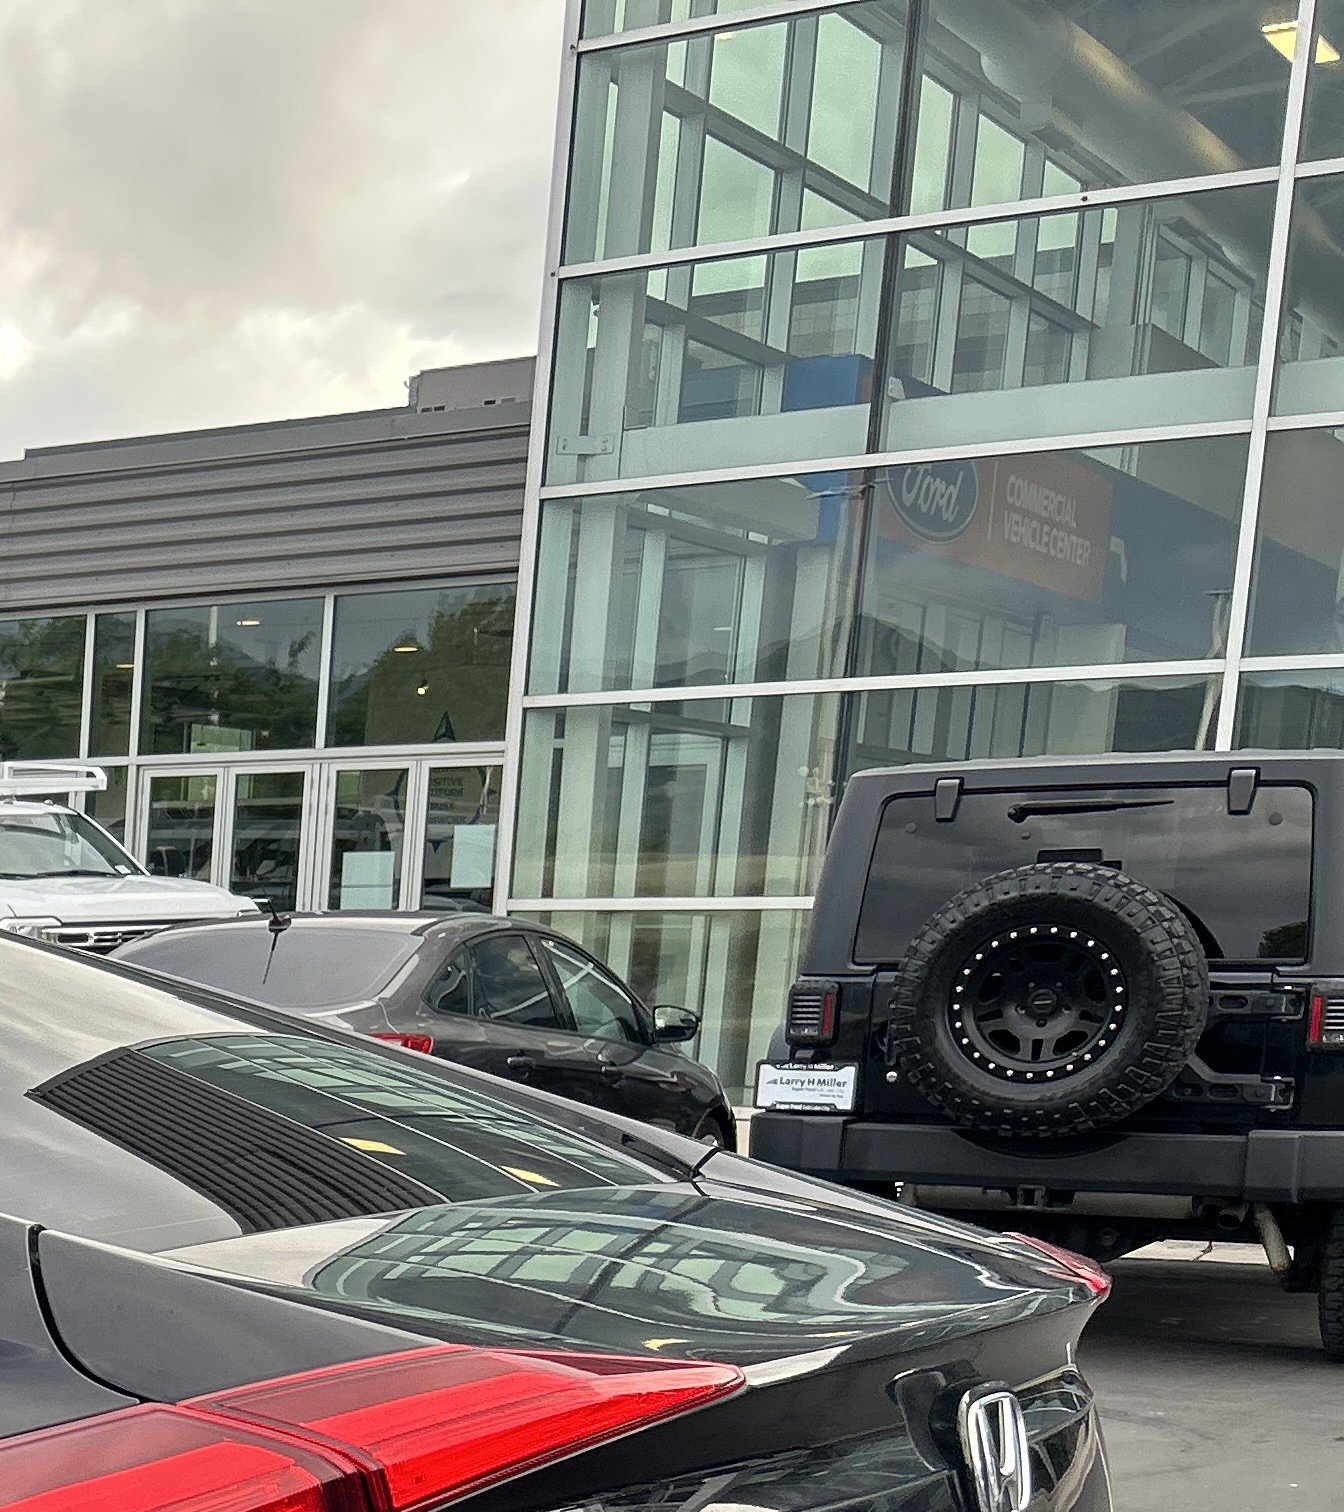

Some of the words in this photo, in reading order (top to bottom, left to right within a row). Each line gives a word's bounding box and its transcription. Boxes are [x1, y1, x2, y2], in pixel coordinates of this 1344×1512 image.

[902, 464, 964, 524] Ford
[1007, 476, 1077, 528] COMMERCIAL
[1004, 510, 1051, 553] VEHICLE
[1050, 522, 1091, 566] CENTER
[779, 1077, 806, 1087] Larry
[817, 1078, 847, 1087] Miller
